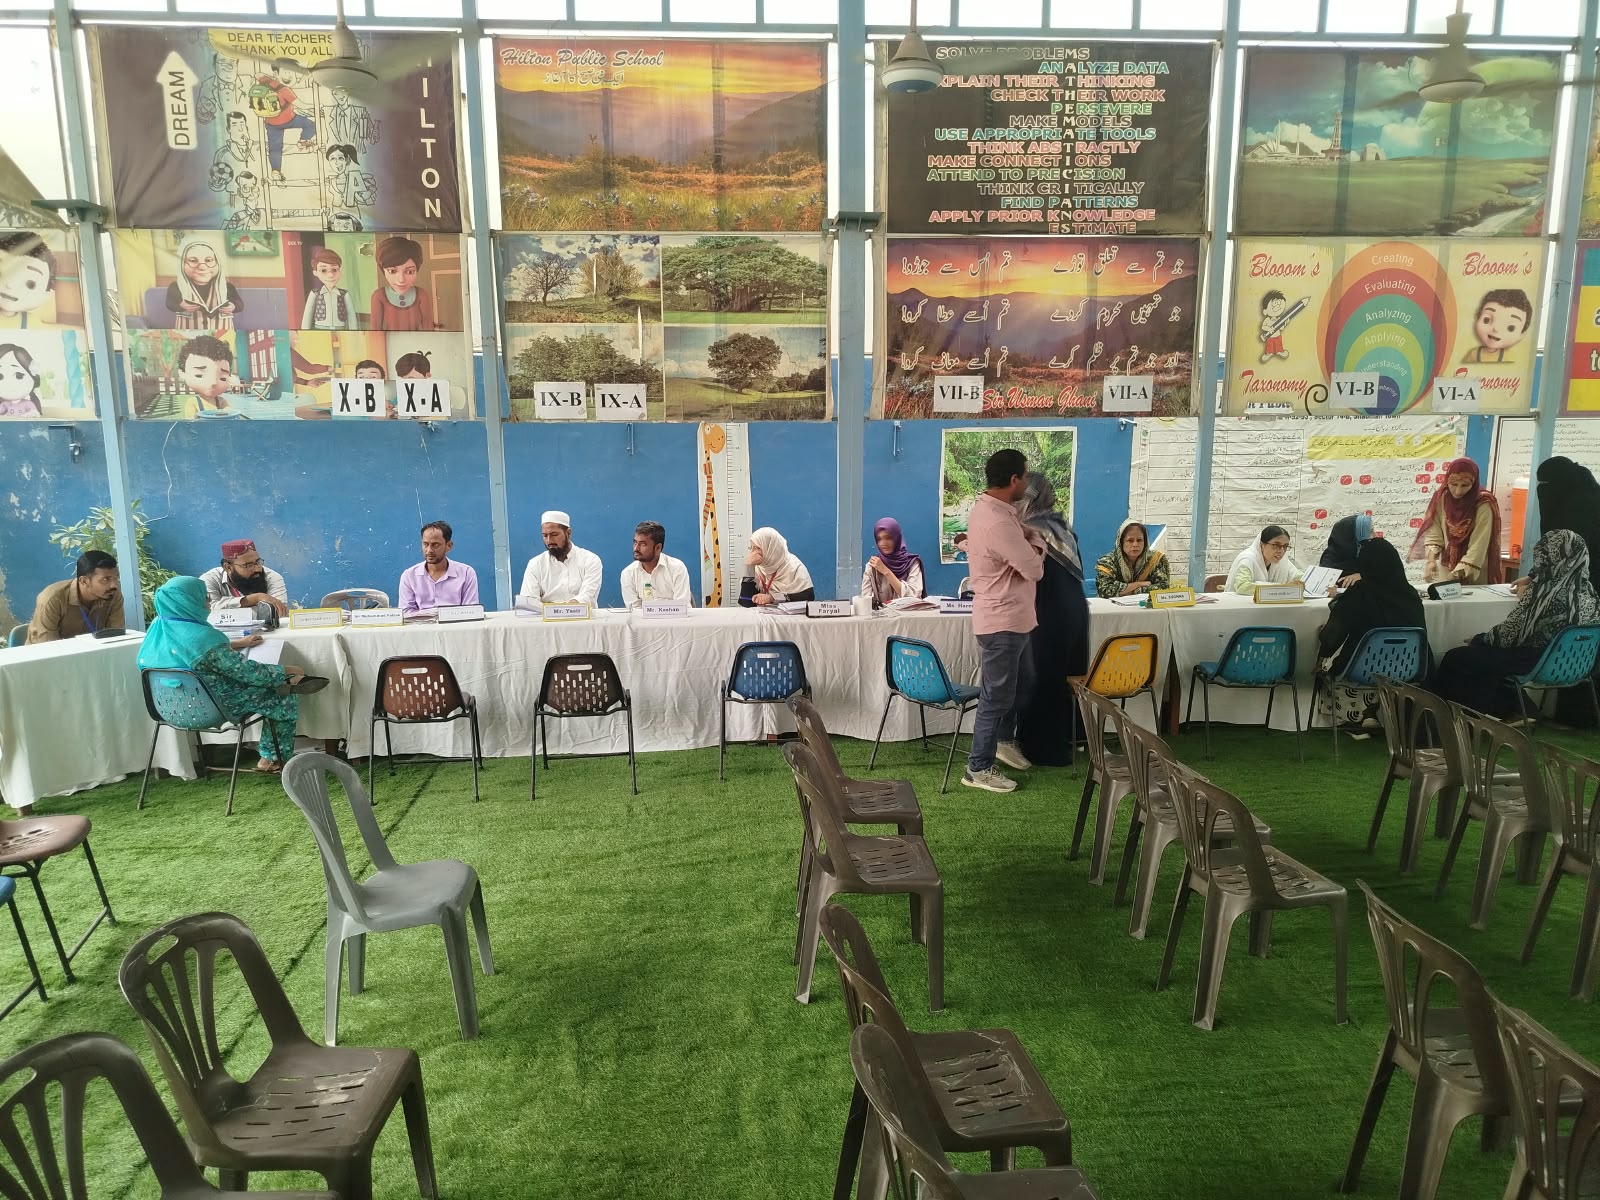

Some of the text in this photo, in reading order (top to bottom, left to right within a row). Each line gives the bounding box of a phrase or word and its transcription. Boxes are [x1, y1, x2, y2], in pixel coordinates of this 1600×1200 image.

[228, 32, 263, 43] DEAR
[232, 44, 333, 56] THANK YOU ALL
[500, 47, 665, 68] Hilton Public School
[1038, 62, 1170, 75] ANALYZE DATA
[938, 75, 1156, 88] XPLAIN THEIR THINKING
[990, 89, 1166, 102] CHECK THEIR WORK
[168, 71, 190, 145] DREAM
[1051, 103, 1153, 115] PERSEVERE
[1009, 115, 1133, 128] MAKE MODELS
[934, 128, 1157, 141] USE APPROPRIATE TOOLS
[967, 142, 1142, 154] THINK ABSTRACTLY
[928, 155, 1112, 168] MAKE CONNECTIONS
[927, 168, 1126, 181] ATTEND TO PRECISION
[977, 182, 1145, 195] THINK CRITICALLY
[1000, 196, 1139, 208] FIND PATTERNS
[928, 209, 1156, 223] APPLY PRIOR KNOWLEDGE
[1049, 223, 1137, 234] ESTIMATE
[939, 263, 960, 275] سے
[999, 250, 1012, 283] تم
[1094, 245, 1119, 277] تعلق
[1126, 262, 1145, 274] سے
[1152, 250, 1165, 283] تم
[1172, 258, 1185, 275] جو
[1371, 254, 1414, 268] Creating
[1364, 278, 1417, 295] Evaluating
[936, 304, 955, 323] عطا
[997, 298, 1011, 331] تم
[1096, 301, 1123, 330] محروم
[1168, 305, 1182, 322] جو
[1364, 308, 1412, 324] Analyzing
[1364, 331, 1406, 347] Applying
[931, 351, 960, 370] معاف
[996, 345, 1009, 378] تم
[1048, 344, 1081, 369] کرے
[1086, 341, 1104, 376] ظلم
[1126, 345, 1139, 376] تم
[1145, 352, 1158, 368] جو
[939, 385, 979, 400] VII-B
[1108, 385, 1149, 400] VII-A
[1240, 369, 1309, 400] Taxonomy
[1335, 381, 1375, 396] VI-B
[540, 391, 582, 407] IX-B
[600, 393, 643, 409] IX-A
[983, 385, 1097, 414] Sir Usman Ghani
[1438, 387, 1477, 400] VI-A
